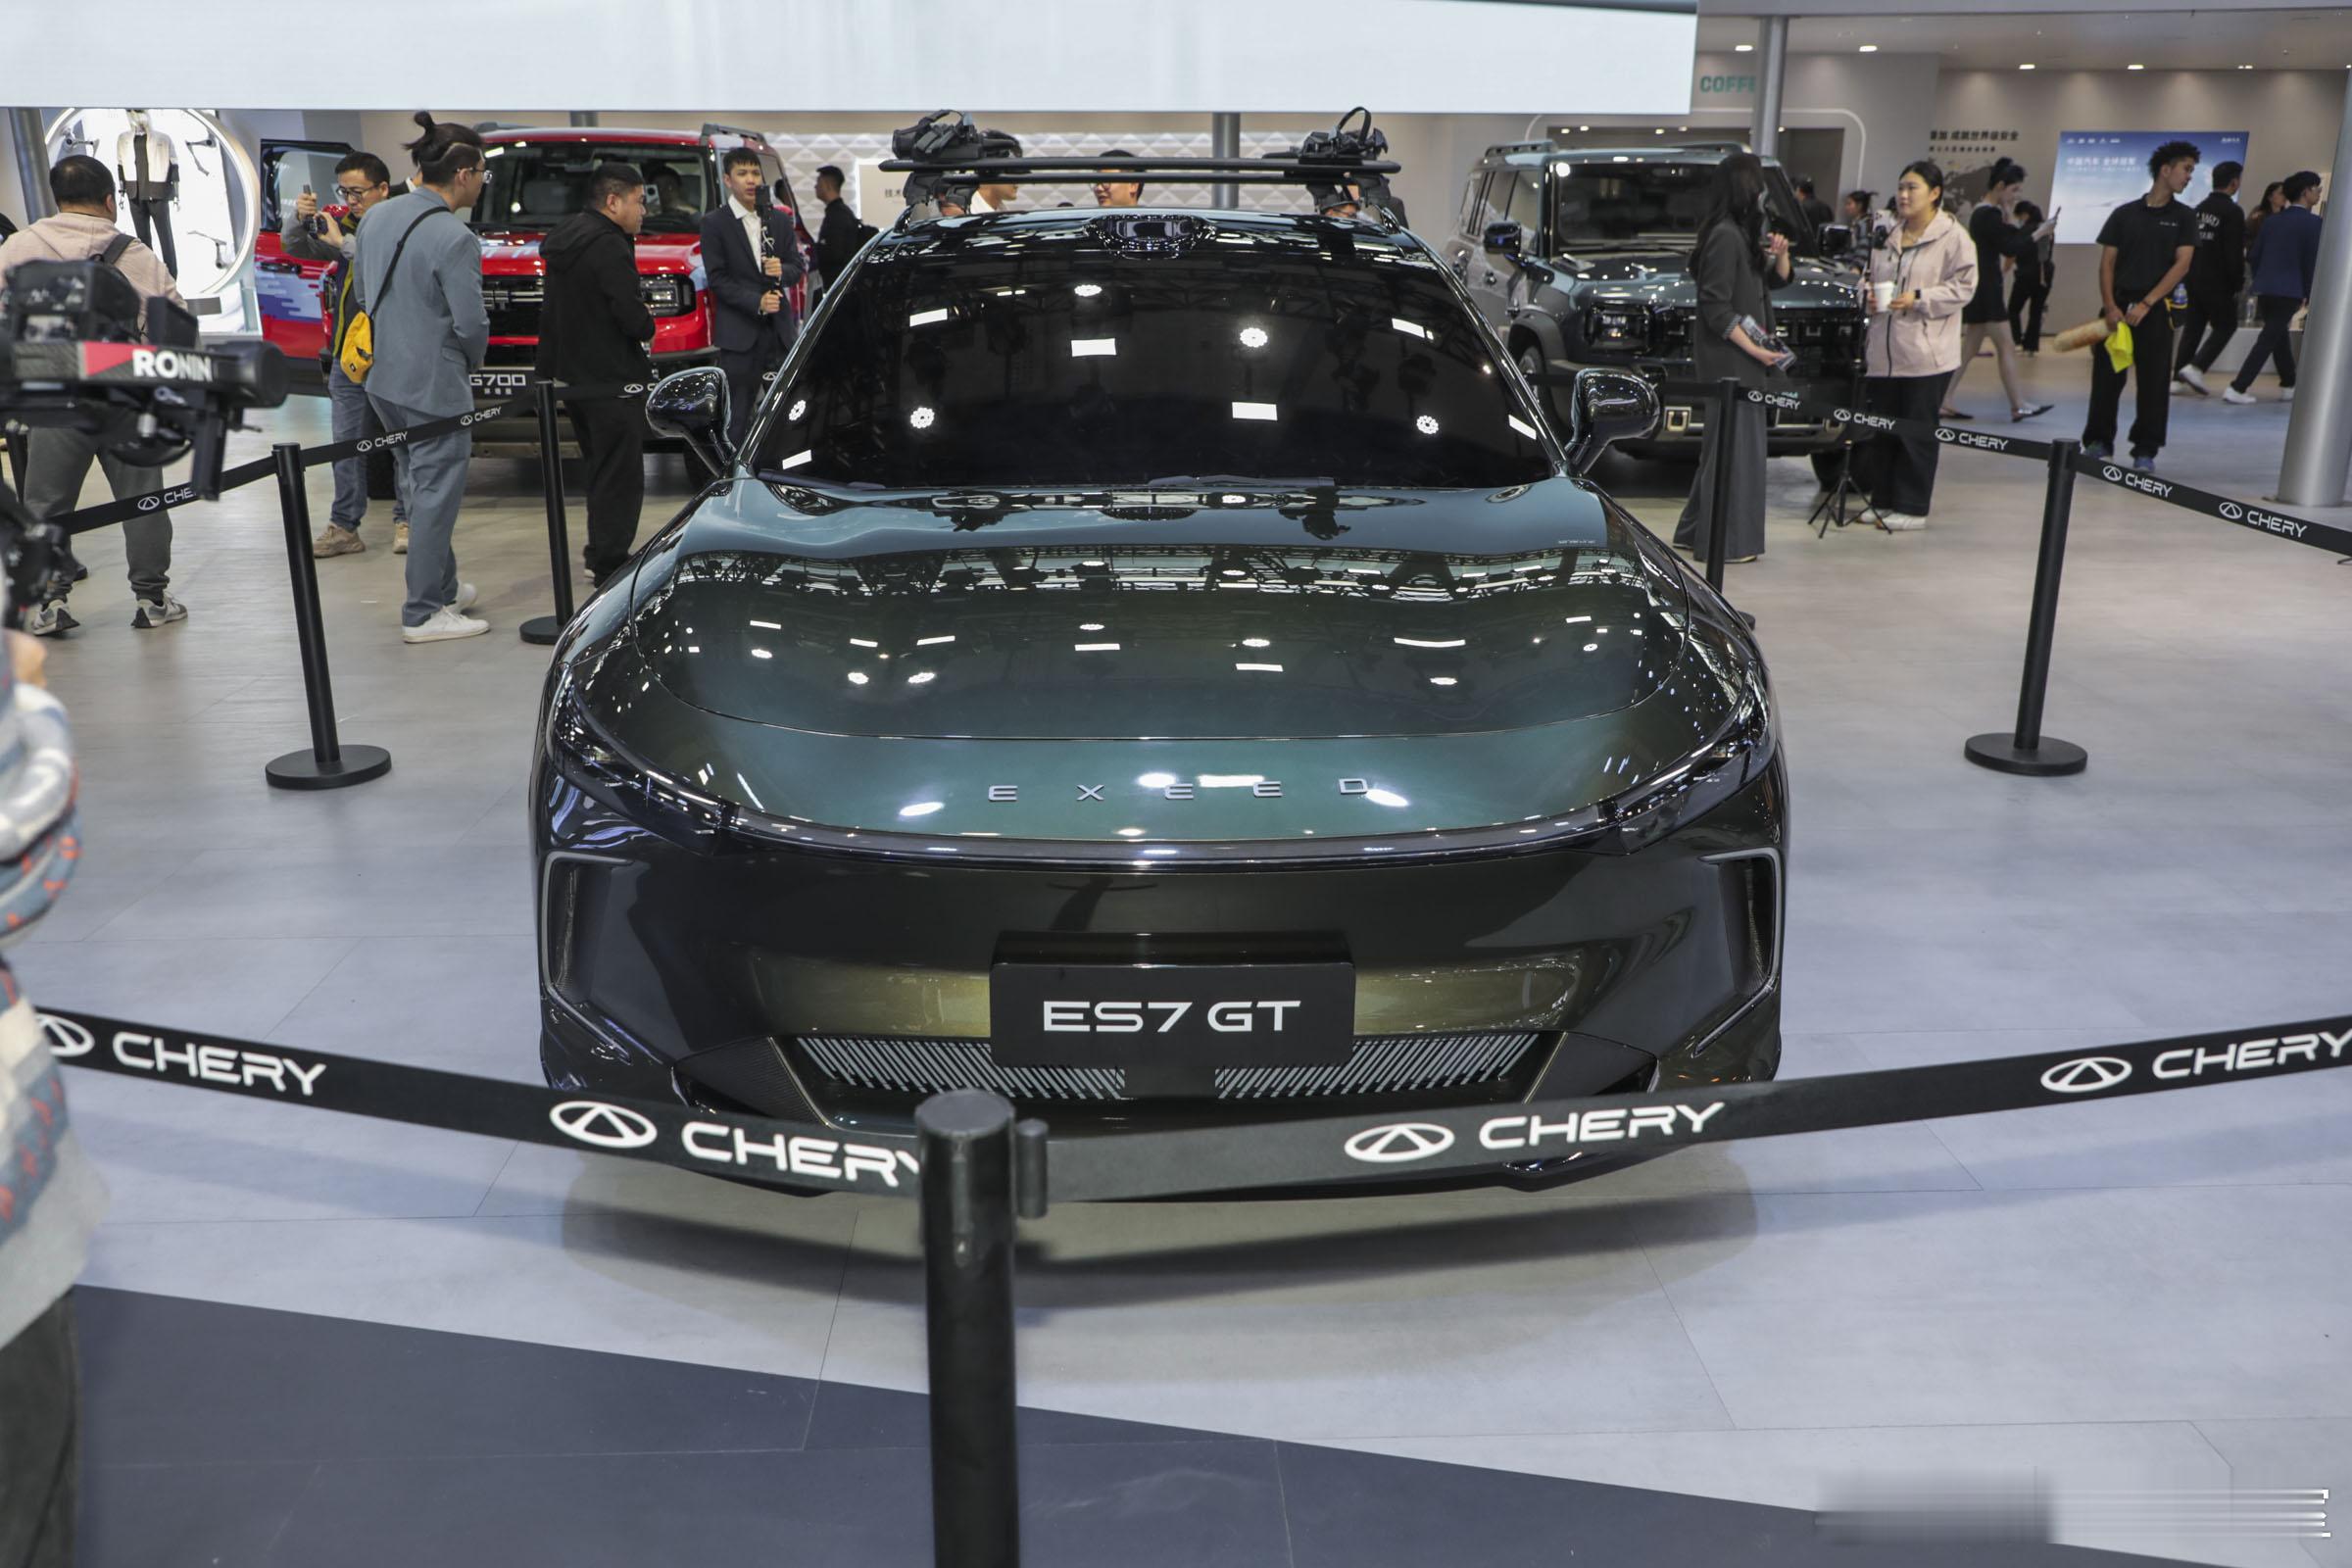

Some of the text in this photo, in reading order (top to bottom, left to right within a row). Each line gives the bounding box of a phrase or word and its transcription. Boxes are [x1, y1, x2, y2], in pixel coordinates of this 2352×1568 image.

[132, 349, 213, 381] RONIN
[468, 373, 526, 386] G700
[474, 406, 502, 422] CHERY
[1764, 393, 1800, 410] CHERY
[1853, 413, 1895, 430] CHERY
[374, 431, 408, 448] CHERY
[1958, 432, 2008, 451] CHERY
[164, 487, 196, 505] CHE
[2125, 472, 2173, 498] CHERY
[2247, 511, 2307, 538] CHERY
[988, 777, 1368, 802] EXEED
[1043, 1000, 1301, 1033] ES7 GT
[112, 1031, 327, 1097] CHERY
[2151, 1028, 2352, 1079] CHERY
[1478, 1102, 1726, 1151] CHERY
